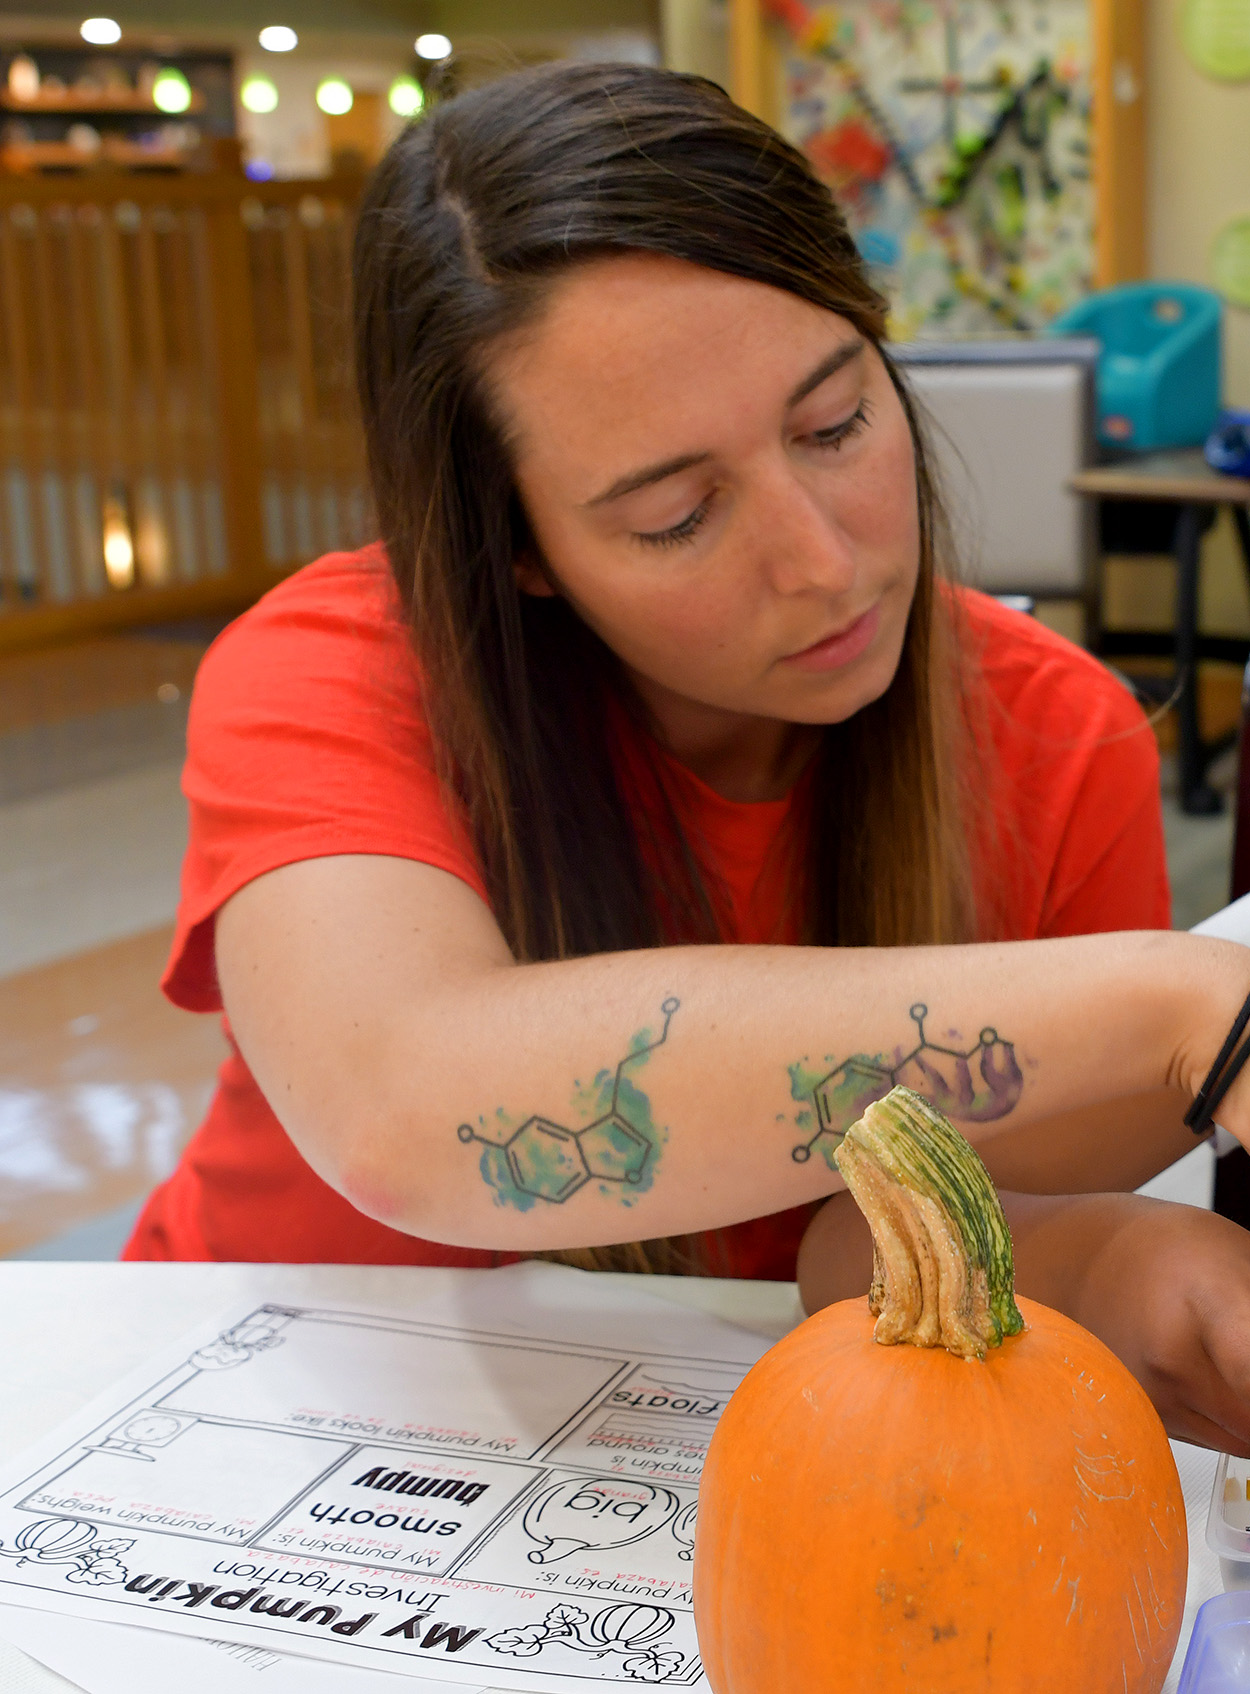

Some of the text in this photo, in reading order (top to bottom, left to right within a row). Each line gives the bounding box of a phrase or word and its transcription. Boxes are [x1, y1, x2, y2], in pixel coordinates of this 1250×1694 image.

[611, 1391, 720, 1415] floats
[331, 1418, 383, 1435] looks
[386, 1426, 481, 1447] pumpkin
[478, 1440, 517, 1452] My
[587, 1438, 669, 1455] around
[611, 1455, 703, 1475] mpkin is
[349, 1467, 491, 1508] bumpy
[31, 1492, 252, 1540] My pumpkin weighs:
[374, 1503, 430, 1516] suave
[564, 1490, 649, 1524] big
[310, 1503, 462, 1536] smooth
[247, 1550, 352, 1573] calabaza
[271, 1533, 441, 1568] My pumpkin is:
[358, 1565, 386, 1580] de
[533, 1571, 561, 1587] is:
[213, 1559, 451, 1615] Investigation
[514, 1589, 536, 1601] Mi
[565, 1574, 672, 1600] pumpkin
[123, 1572, 488, 1654] My Pumpkin
